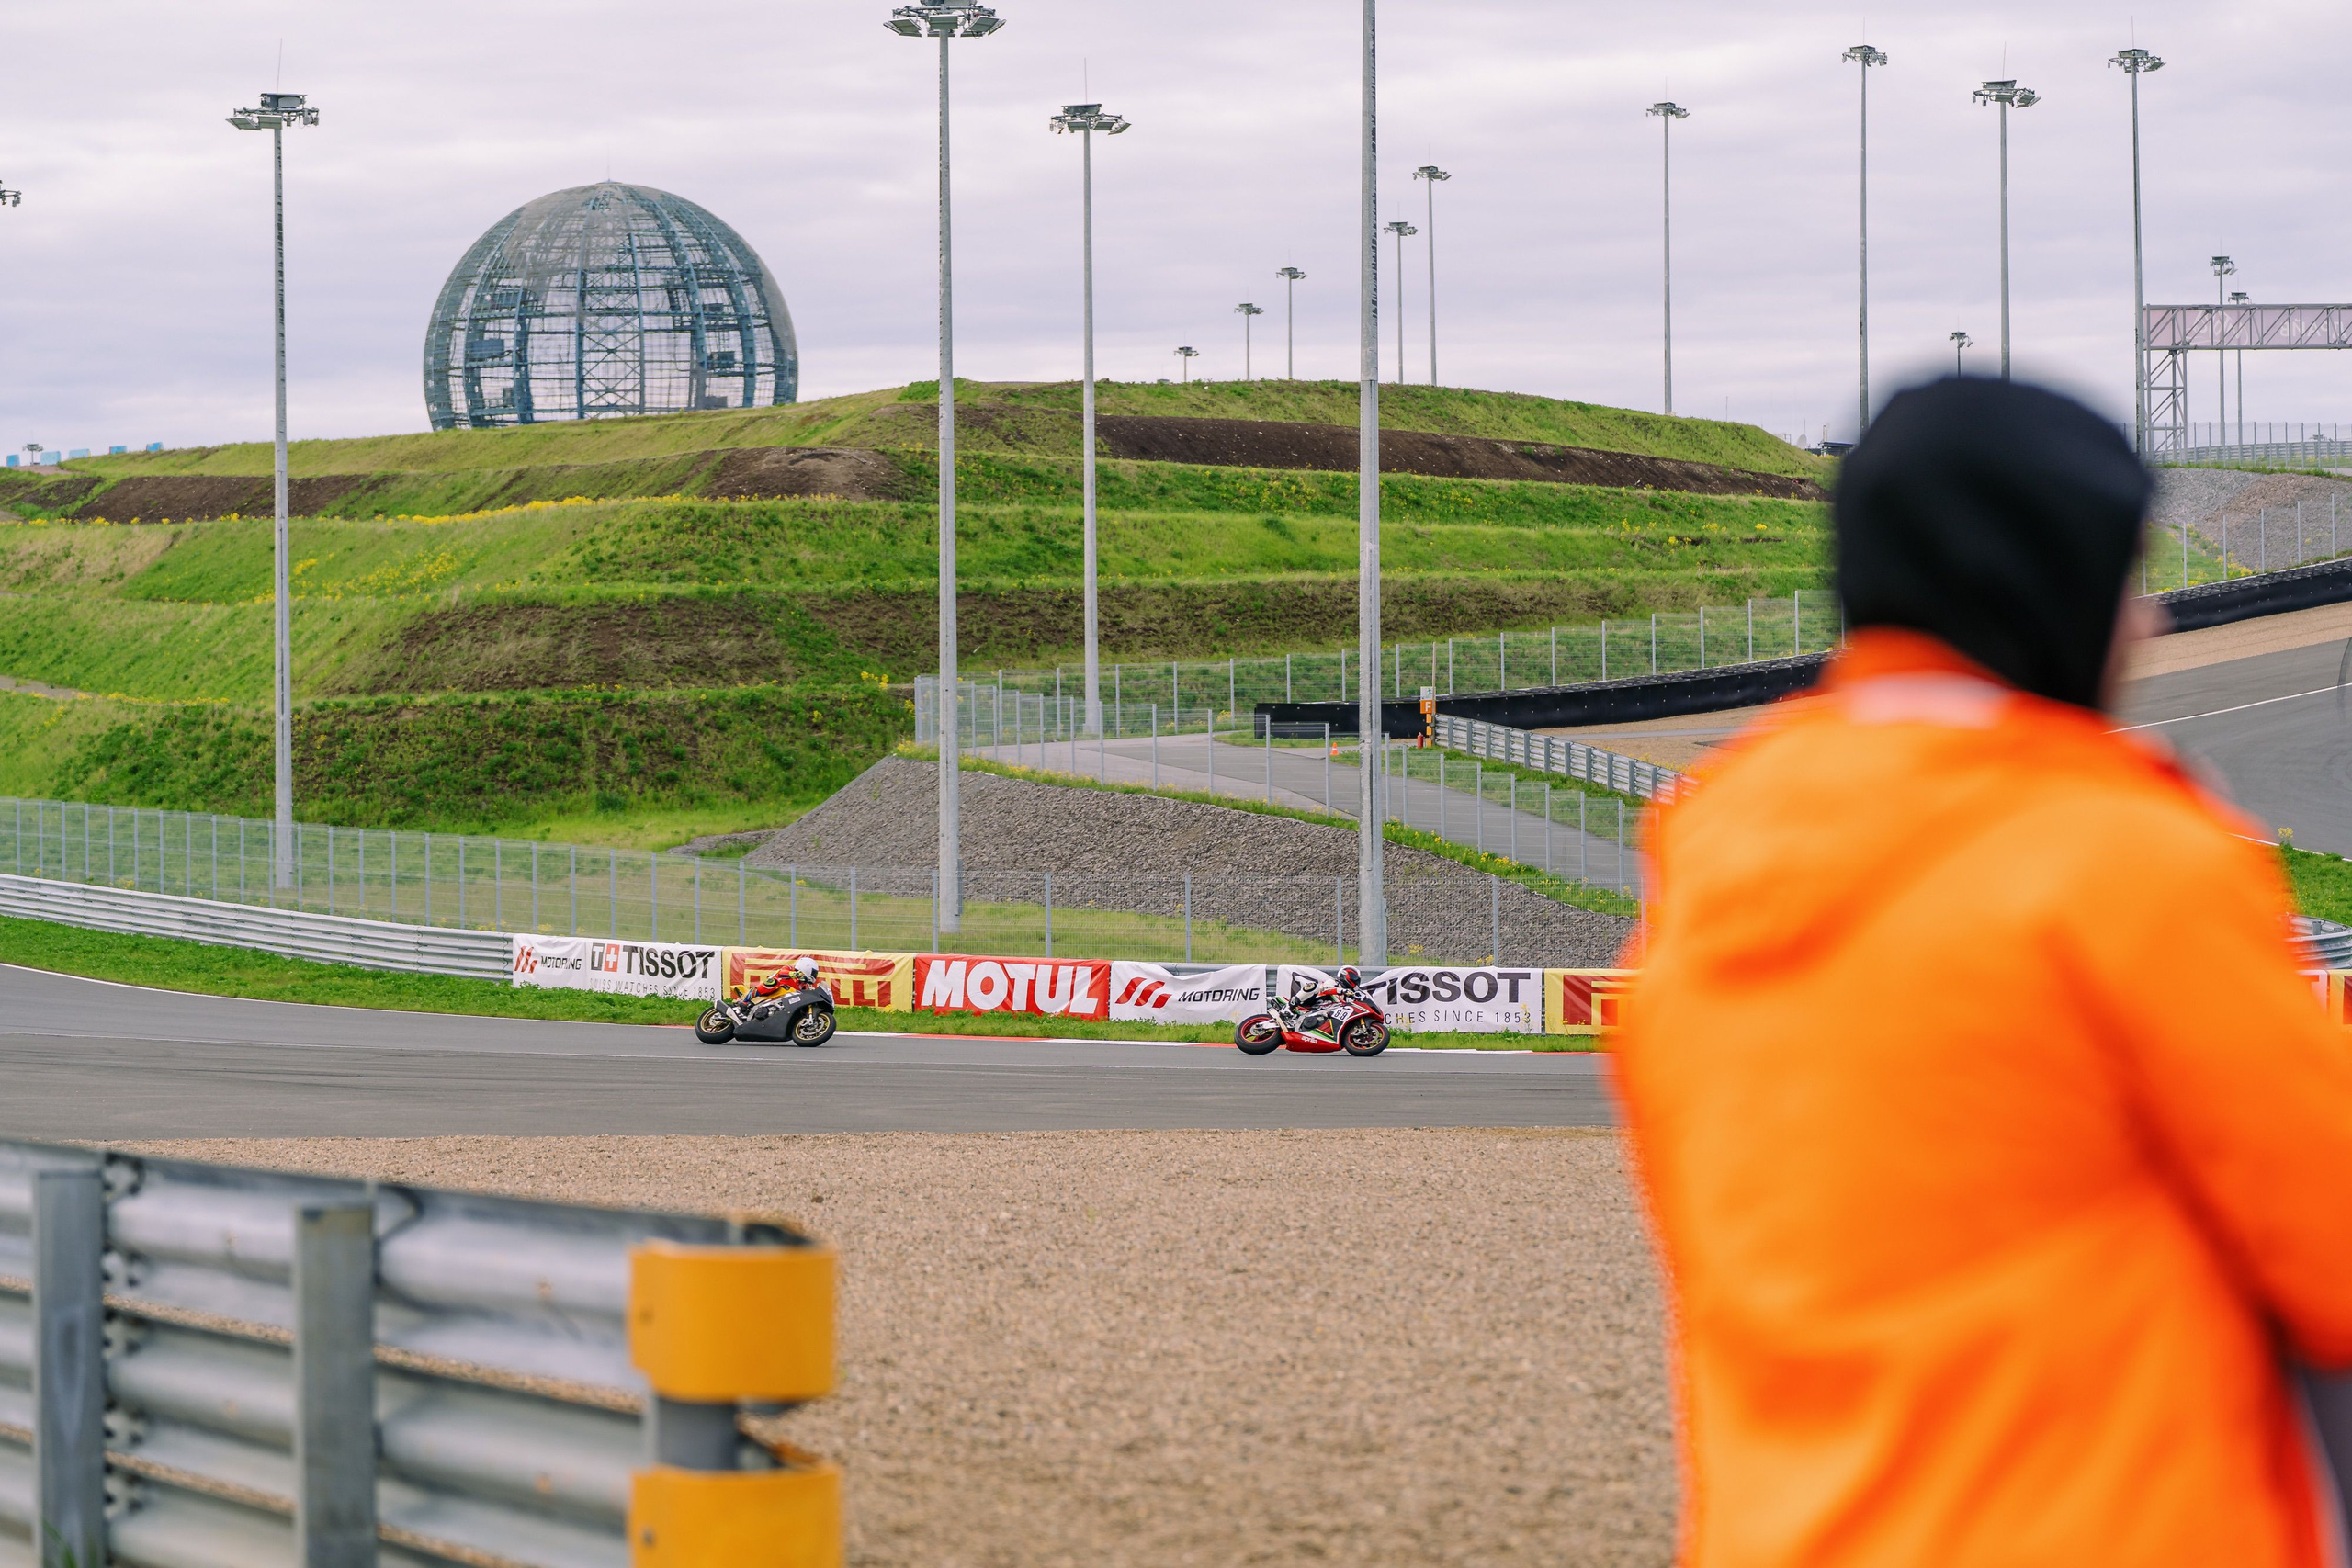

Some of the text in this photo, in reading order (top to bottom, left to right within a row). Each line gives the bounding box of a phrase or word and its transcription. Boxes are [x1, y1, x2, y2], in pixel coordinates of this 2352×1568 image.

[1425, 701, 1432, 712] F
[540, 956, 582, 970] MOTORING
[622, 945, 716, 979] TISSOT
[589, 977, 612, 991] SWISS
[615, 980, 659, 995] WATCHES
[693, 986, 716, 998] 1853
[921, 959, 1099, 1015] MOTUL
[1178, 987, 1261, 1003] MOTORING
[1433, 1010, 1484, 1023] SINCE
[1494, 1011, 1532, 1024] 1853
[1301, 1035, 1318, 1044] aprilia
